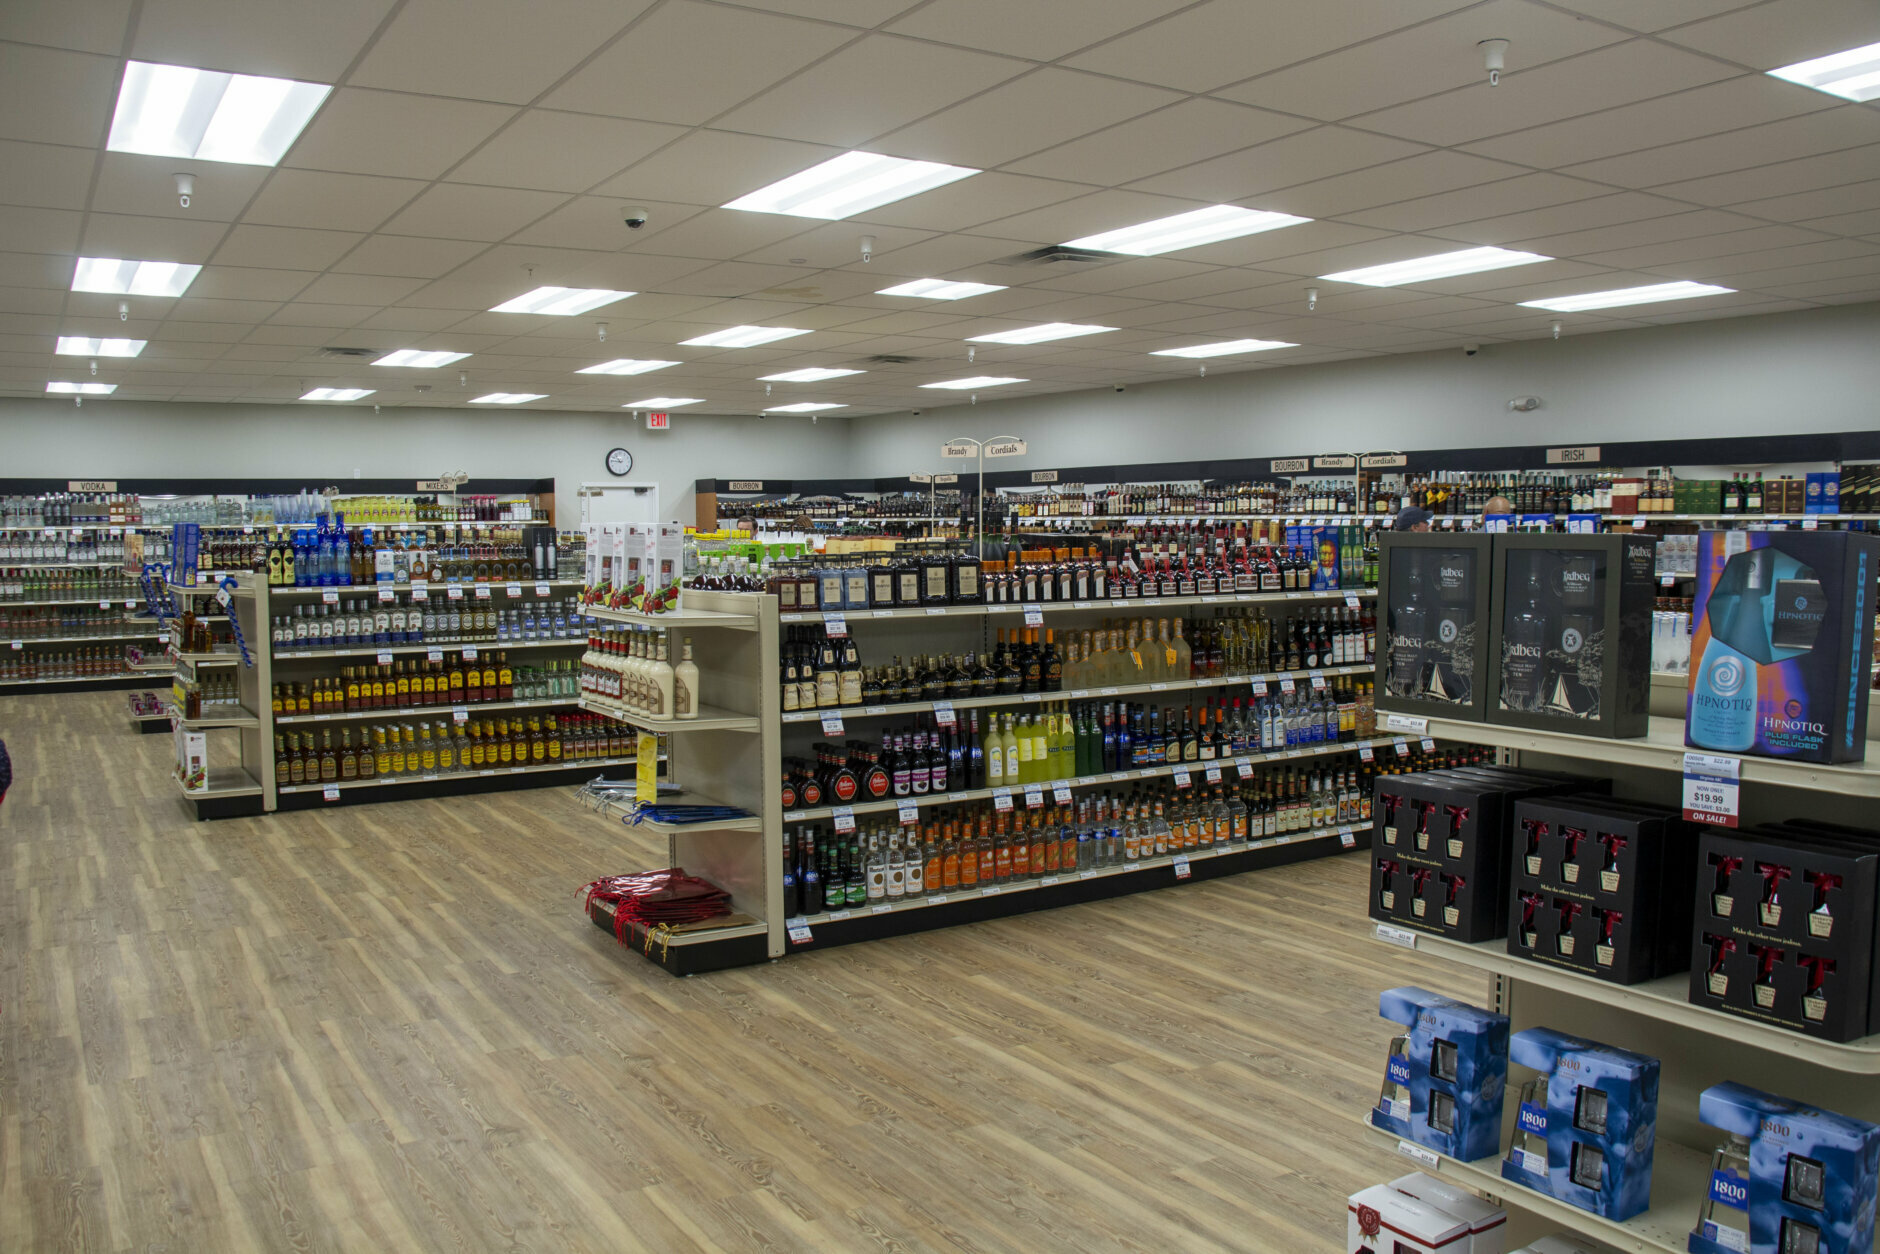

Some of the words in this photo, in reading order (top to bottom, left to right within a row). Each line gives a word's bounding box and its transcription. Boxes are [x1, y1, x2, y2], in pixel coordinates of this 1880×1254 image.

[651, 413, 667, 427] EXIT
[947, 447, 968, 457] Brandy
[990, 444, 1018, 455] Cordials
[1561, 449, 1585, 461] IRISH
[1274, 460, 1305, 471] BOURBON
[1321, 458, 1344, 467] Brandy
[1367, 457, 1397, 466] Cordials
[1033, 472, 1055, 481] BOURBON
[81, 482, 106, 491] VODKA
[732, 482, 759, 490] BOURBON
[1845, 552, 1867, 748] #SINCE2001
[1697, 693, 1753, 711] HPNOTIQ
[1764, 716, 1829, 736] HPNOTIQ
[1765, 731, 1790, 739] PLUS
[1792, 734, 1824, 744] FLASK
[1769, 739, 1818, 750] INCLUDED
[1694, 792, 1724, 804] $19.99
[1692, 812, 1705, 820] ON
[1706, 814, 1727, 824] SALE!
[1732, 926, 1746, 935] Make
[1557, 1056, 1580, 1071] 1800
[1522, 1110, 1547, 1128] 1800
[1760, 1119, 1790, 1137] 1800
[1714, 1179, 1747, 1200] 1800
